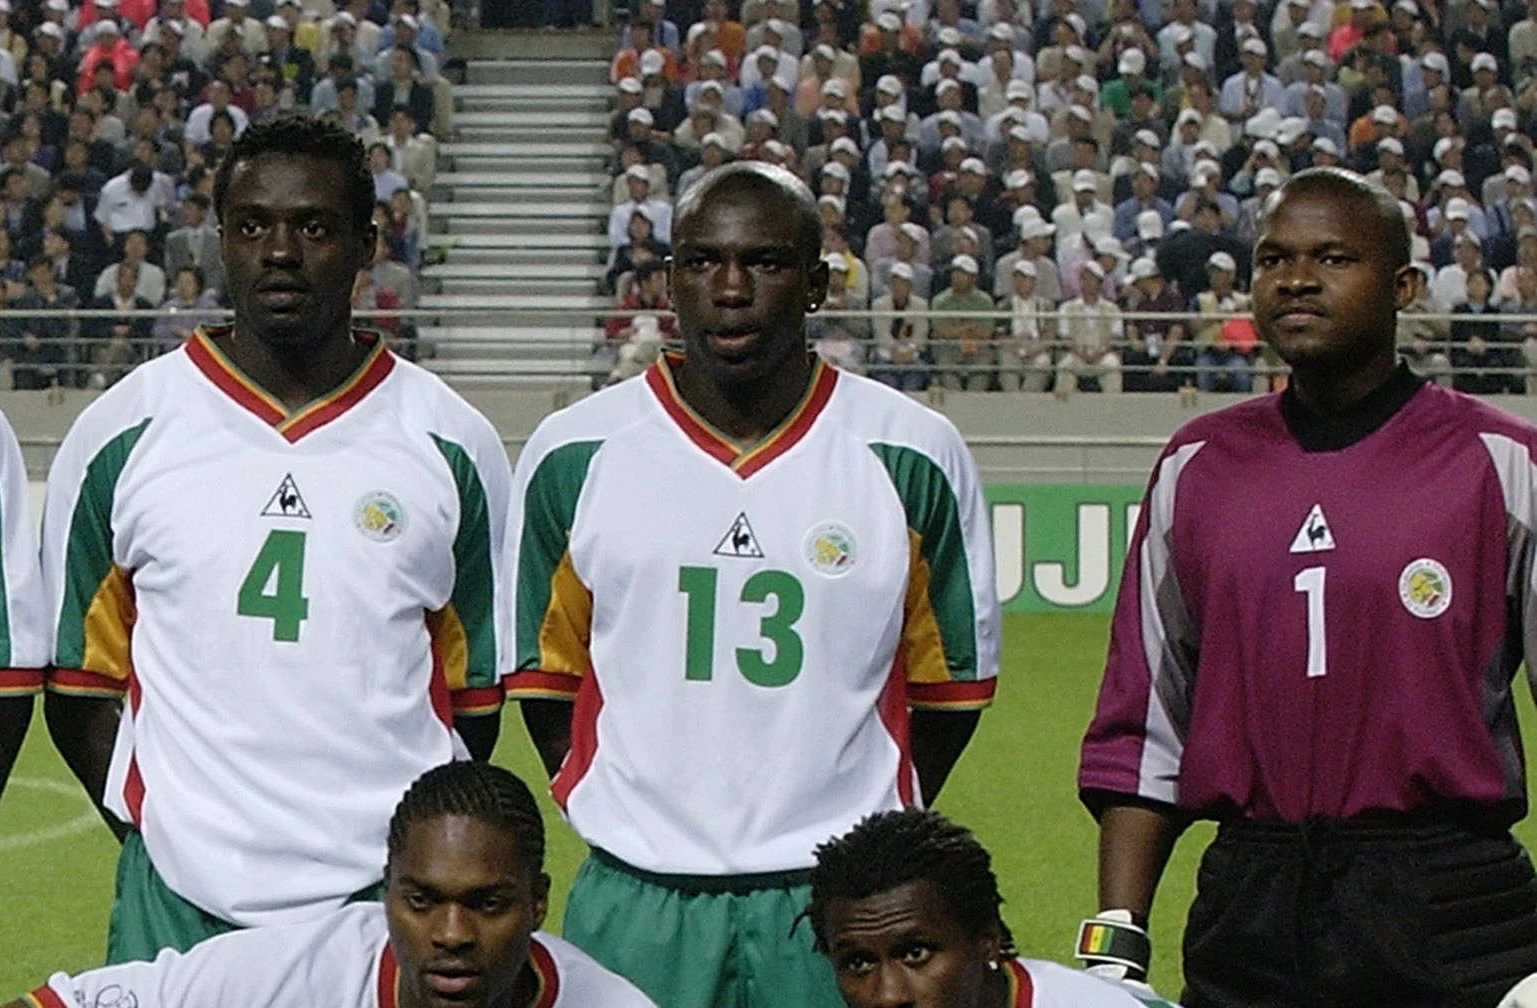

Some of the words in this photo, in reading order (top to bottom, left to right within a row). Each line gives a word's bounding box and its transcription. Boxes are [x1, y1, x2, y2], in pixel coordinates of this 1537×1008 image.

[237, 529, 309, 642] 4
[679, 566, 806, 688] 13
[1294, 566, 1327, 677] 1
